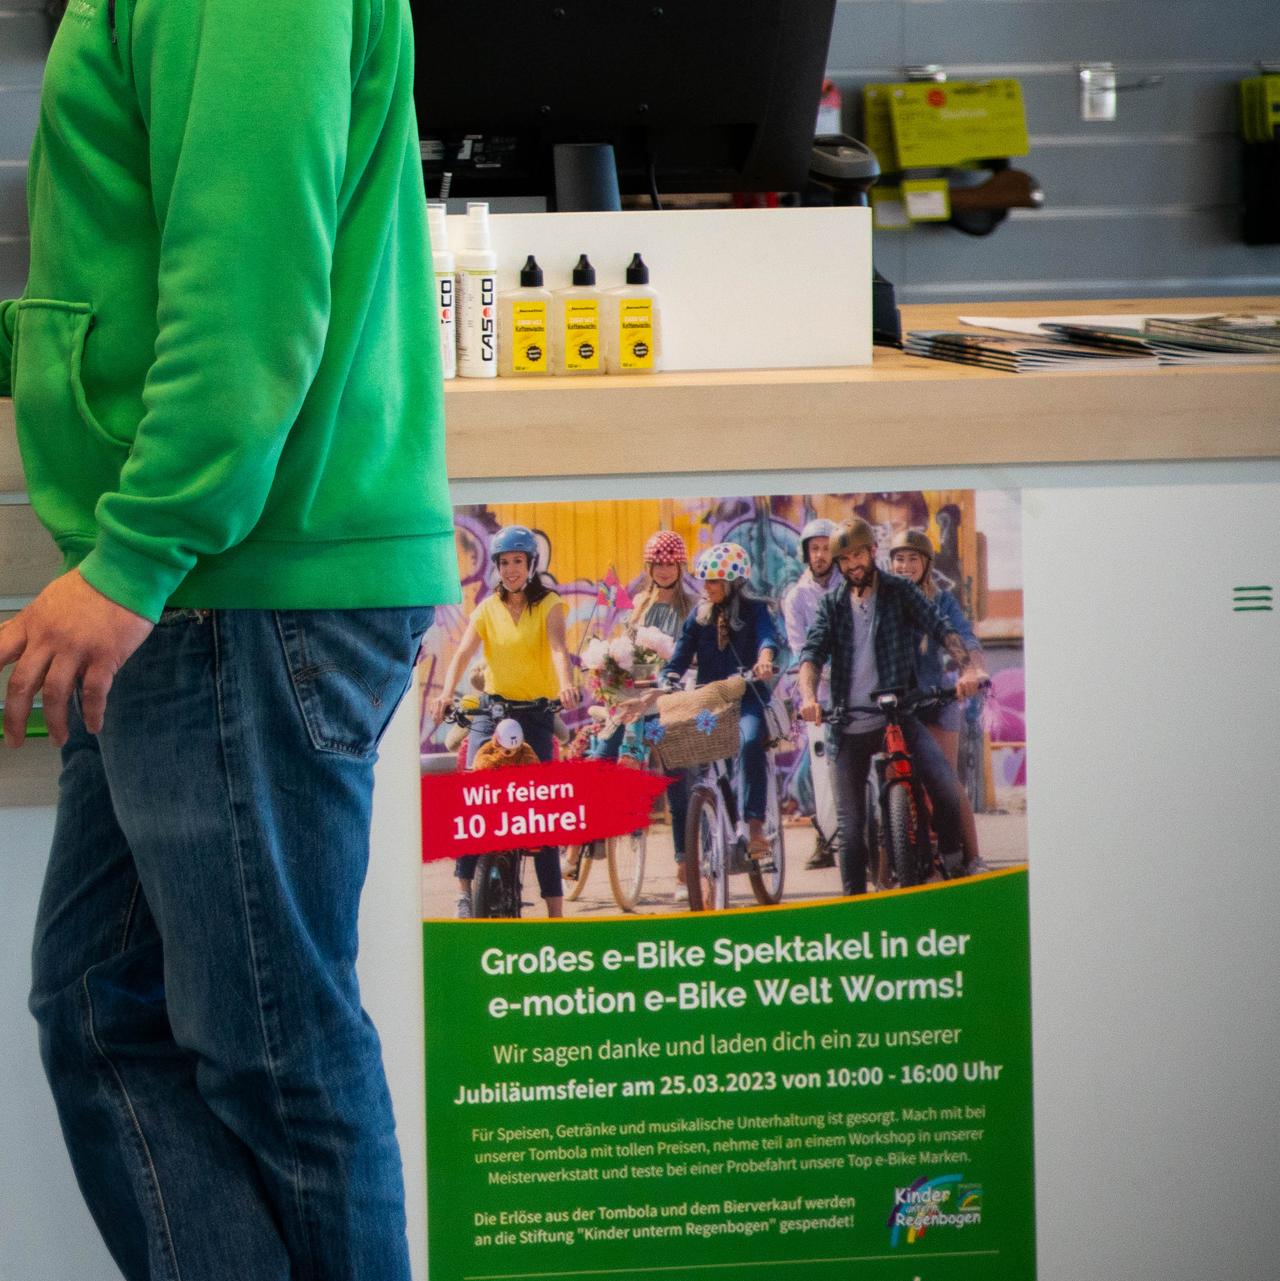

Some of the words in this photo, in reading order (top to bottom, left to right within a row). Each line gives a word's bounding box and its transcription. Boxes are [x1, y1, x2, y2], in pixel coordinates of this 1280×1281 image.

[463, 784, 501, 806] Wir
[507, 781, 574, 803] feiern
[453, 814, 486, 840] 10
[494, 805, 587, 836] Jahre!
[481, 946, 594, 975] Großes
[602, 940, 705, 970] e-Bike
[713, 932, 873, 972] Spektakel
[881, 931, 908, 958] in
[917, 929, 970, 957] der
[489, 986, 636, 1018] e-motion
[644, 981, 747, 1011] e-Bike
[754, 976, 833, 1006] Welt
[840, 971, 963, 1003] Worms!
[493, 1044, 527, 1064] Wir
[532, 1044, 592, 1067] sagen
[598, 1038, 661, 1060] danke
[666, 1035, 705, 1056] und
[710, 1033, 767, 1054] laden
[772, 1030, 815, 1052] dich
[820, 1029, 851, 1049] ein
[857, 1032, 879, 1048] zu
[885, 1028, 962, 1047] unserer
[454, 1078, 616, 1105] Jubiläumsfeier
[621, 1079, 655, 1097] am
[660, 1072, 777, 1095] 25.03.2023
[782, 1072, 820, 1088] von
[826, 1067, 883, 1088] 10:00
[901, 1064, 957, 1084] 16:00
[963, 1061, 1003, 1081] Uhr
[472, 1128, 493, 1142] Für
[497, 1126, 554, 1143] Speisen,
[556, 1123, 616, 1138] Getränke
[619, 1120, 645, 1135] und
[648, 1117, 734, 1134] musikalische
[737, 1112, 825, 1130] Unterhaltung
[828, 1111, 843, 1125] ist
[846, 1111, 899, 1127] gesorgt.
[902, 1107, 936, 1122] Mach
[941, 1106, 962, 1120] mit
[965, 1105, 986, 1118] bei
[475, 1151, 526, 1164] unserer
[529, 1147, 587, 1161] Tombola
[591, 1145, 612, 1158] mit
[616, 1142, 654, 1157] tollen
[657, 1140, 710, 1155] Preisen,
[713, 1137, 759, 1152] nehme
[762, 1135, 782, 1149] teil
[786, 1138, 802, 1148] an
[805, 1134, 846, 1147] einem
[848, 1131, 915, 1146] Workshop
[919, 1129, 931, 1142] in
[934, 1129, 984, 1142] unserer
[489, 1166, 598, 1184] Meisterwerkstatt
[602, 1165, 628, 1179] und
[631, 1164, 664, 1177] teste
[666, 1162, 687, 1176] bei
[690, 1160, 723, 1175] einer
[727, 1158, 797, 1173] Probefahrt
[800, 1157, 844, 1169] unsere
[848, 1154, 872, 1169] Top
[875, 1152, 916, 1166] e-Bike
[919, 1150, 972, 1164] Marken.
[474, 1213, 496, 1226] Die
[500, 1211, 541, 1225] Erlöse
[545, 1210, 569, 1222] aus
[572, 1208, 595, 1222] der
[598, 1205, 657, 1220] Tombola
[661, 1203, 687, 1217] und
[690, 1201, 721, 1216] dem
[723, 1196, 802, 1213] Bierverkauf
[805, 1196, 855, 1209] werden
[895, 1187, 951, 1205] Kinder
[474, 1234, 491, 1246] an
[495, 1231, 517, 1245] die
[519, 1229, 575, 1245] Stiftung
[577, 1226, 630, 1240] "Kinder
[633, 1223, 683, 1238] unterm
[686, 1218, 777, 1238] Regenbogen"
[779, 1215, 854, 1234] gespendet!
[896, 1212, 981, 1231] Regenbogen
